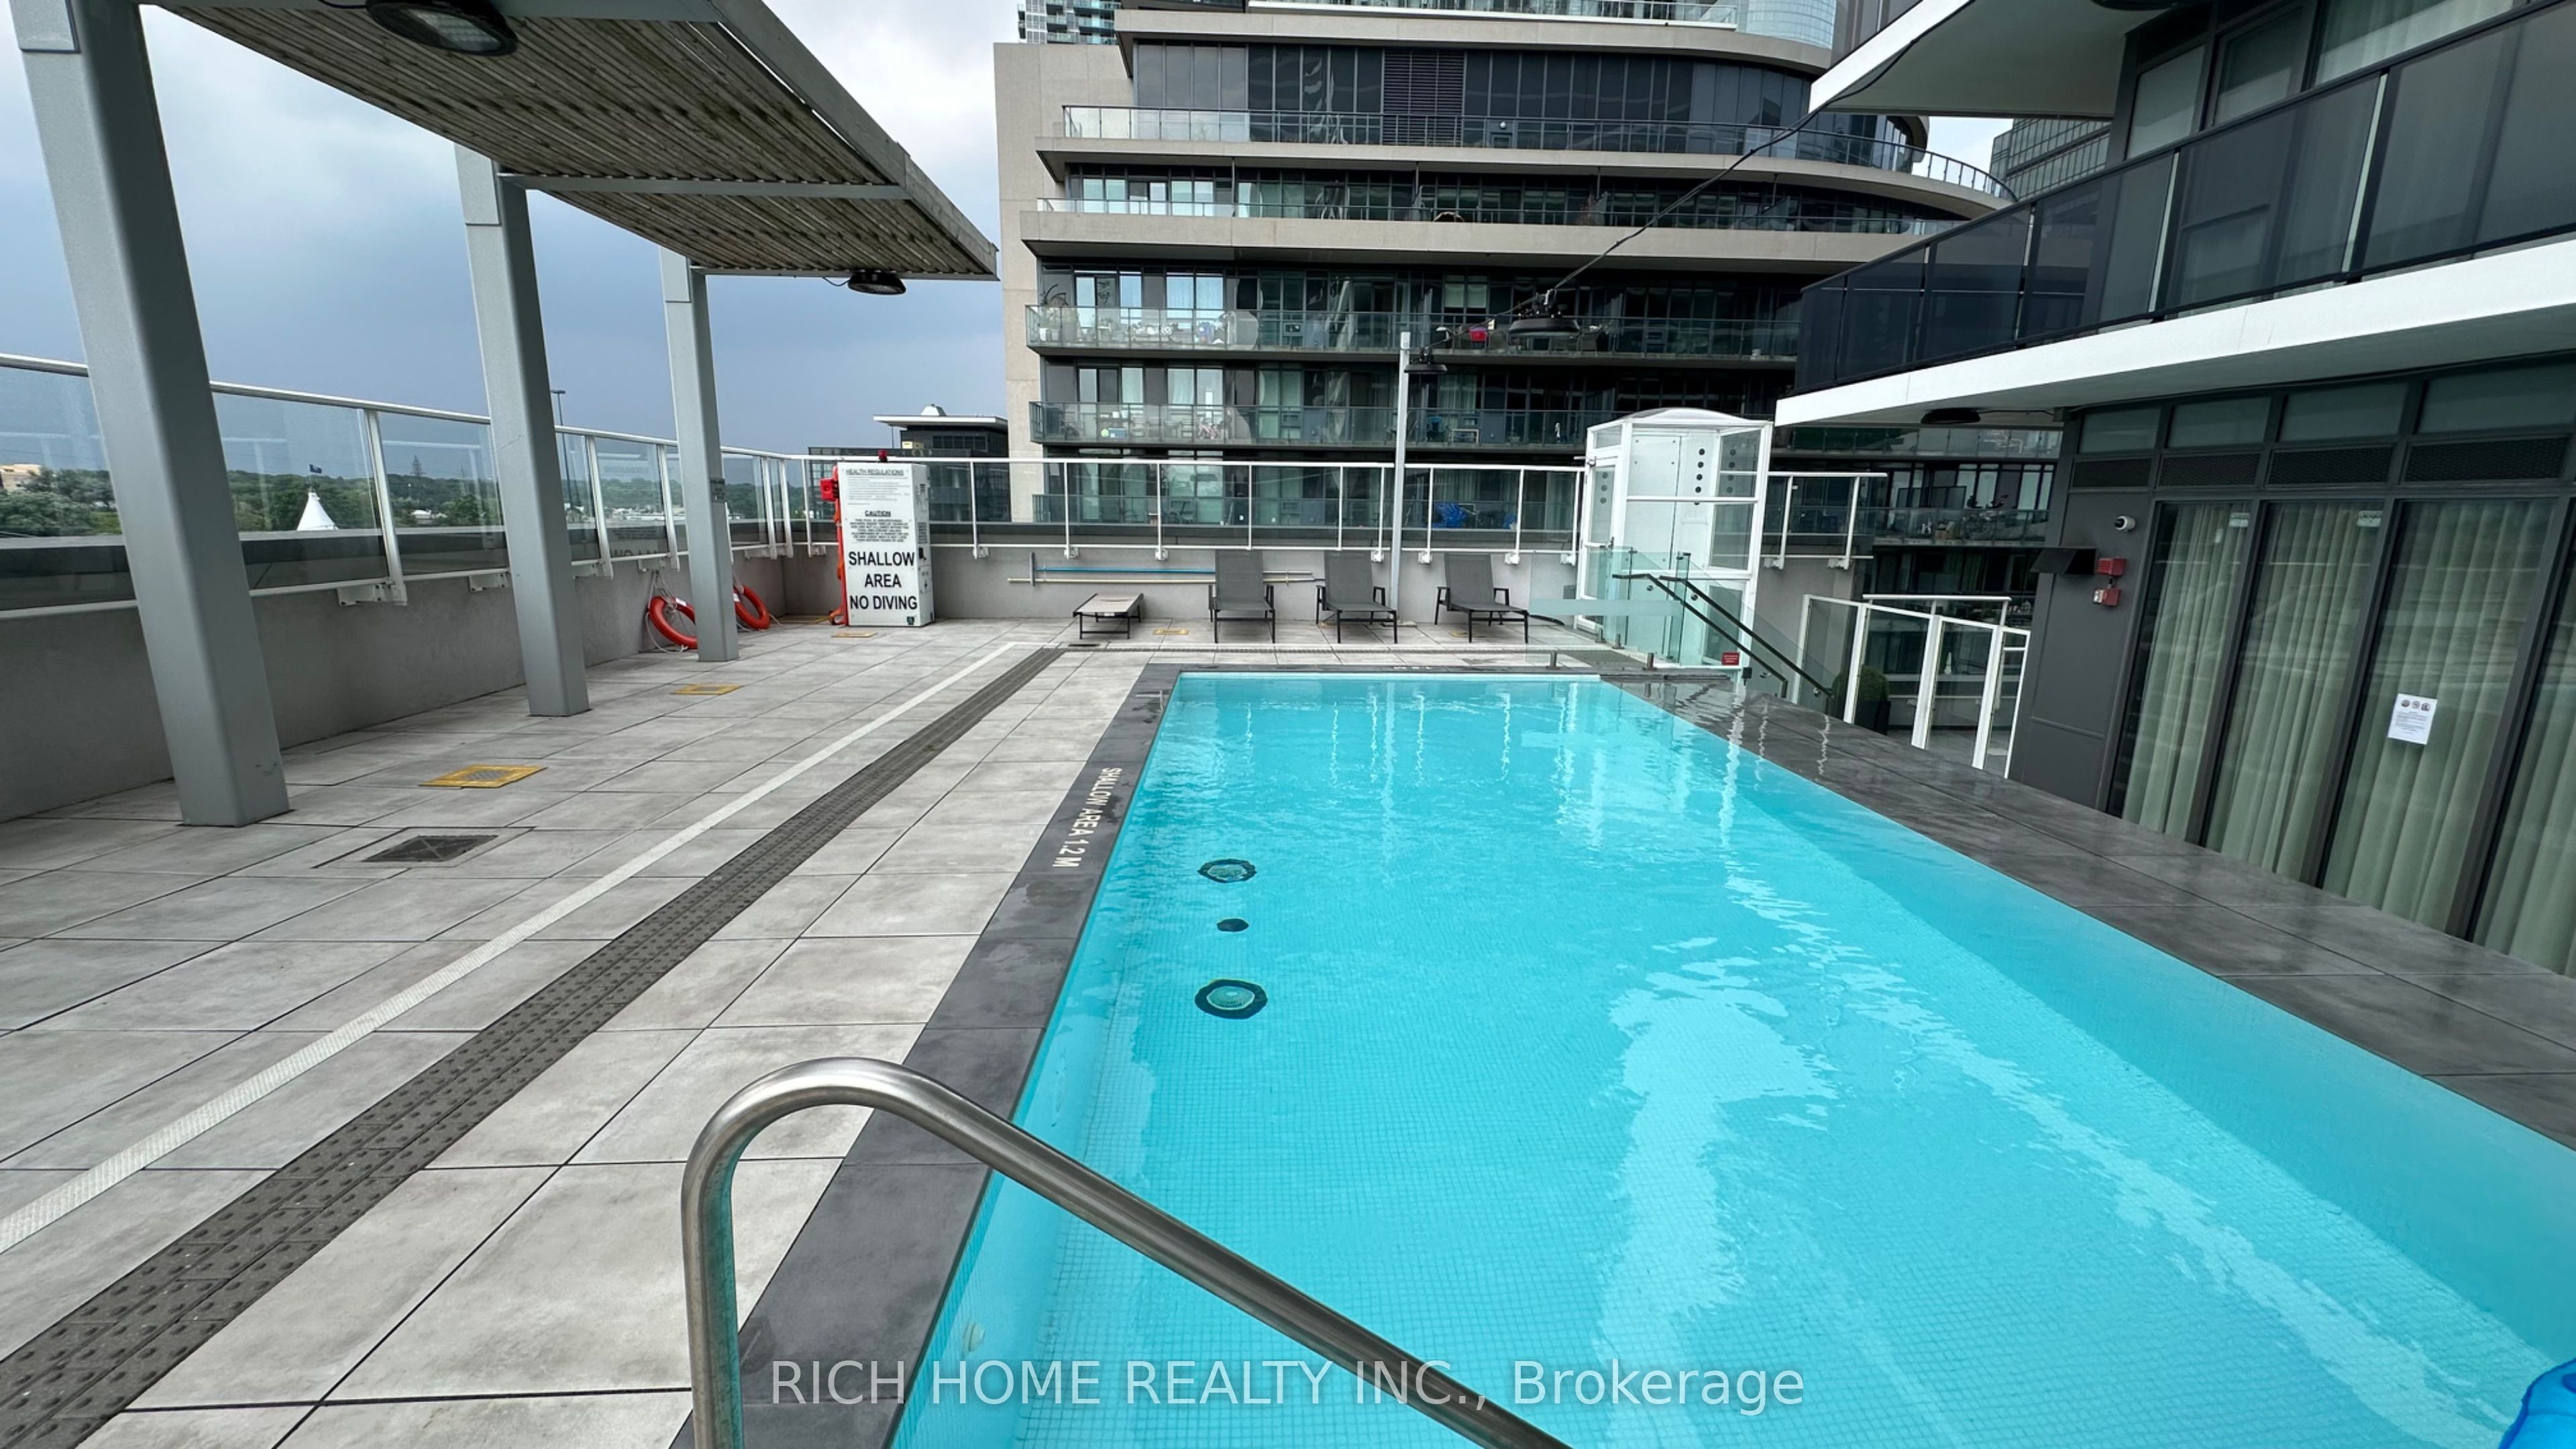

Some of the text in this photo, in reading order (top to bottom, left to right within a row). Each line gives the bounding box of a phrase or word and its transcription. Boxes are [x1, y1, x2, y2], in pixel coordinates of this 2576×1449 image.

[849, 551, 915, 566] SHALLOW
[864, 574, 902, 588] AREA
[849, 595, 918, 610] NO DIVING
[1052, 767, 1122, 867] SHALLOW AREA 1.2 M
